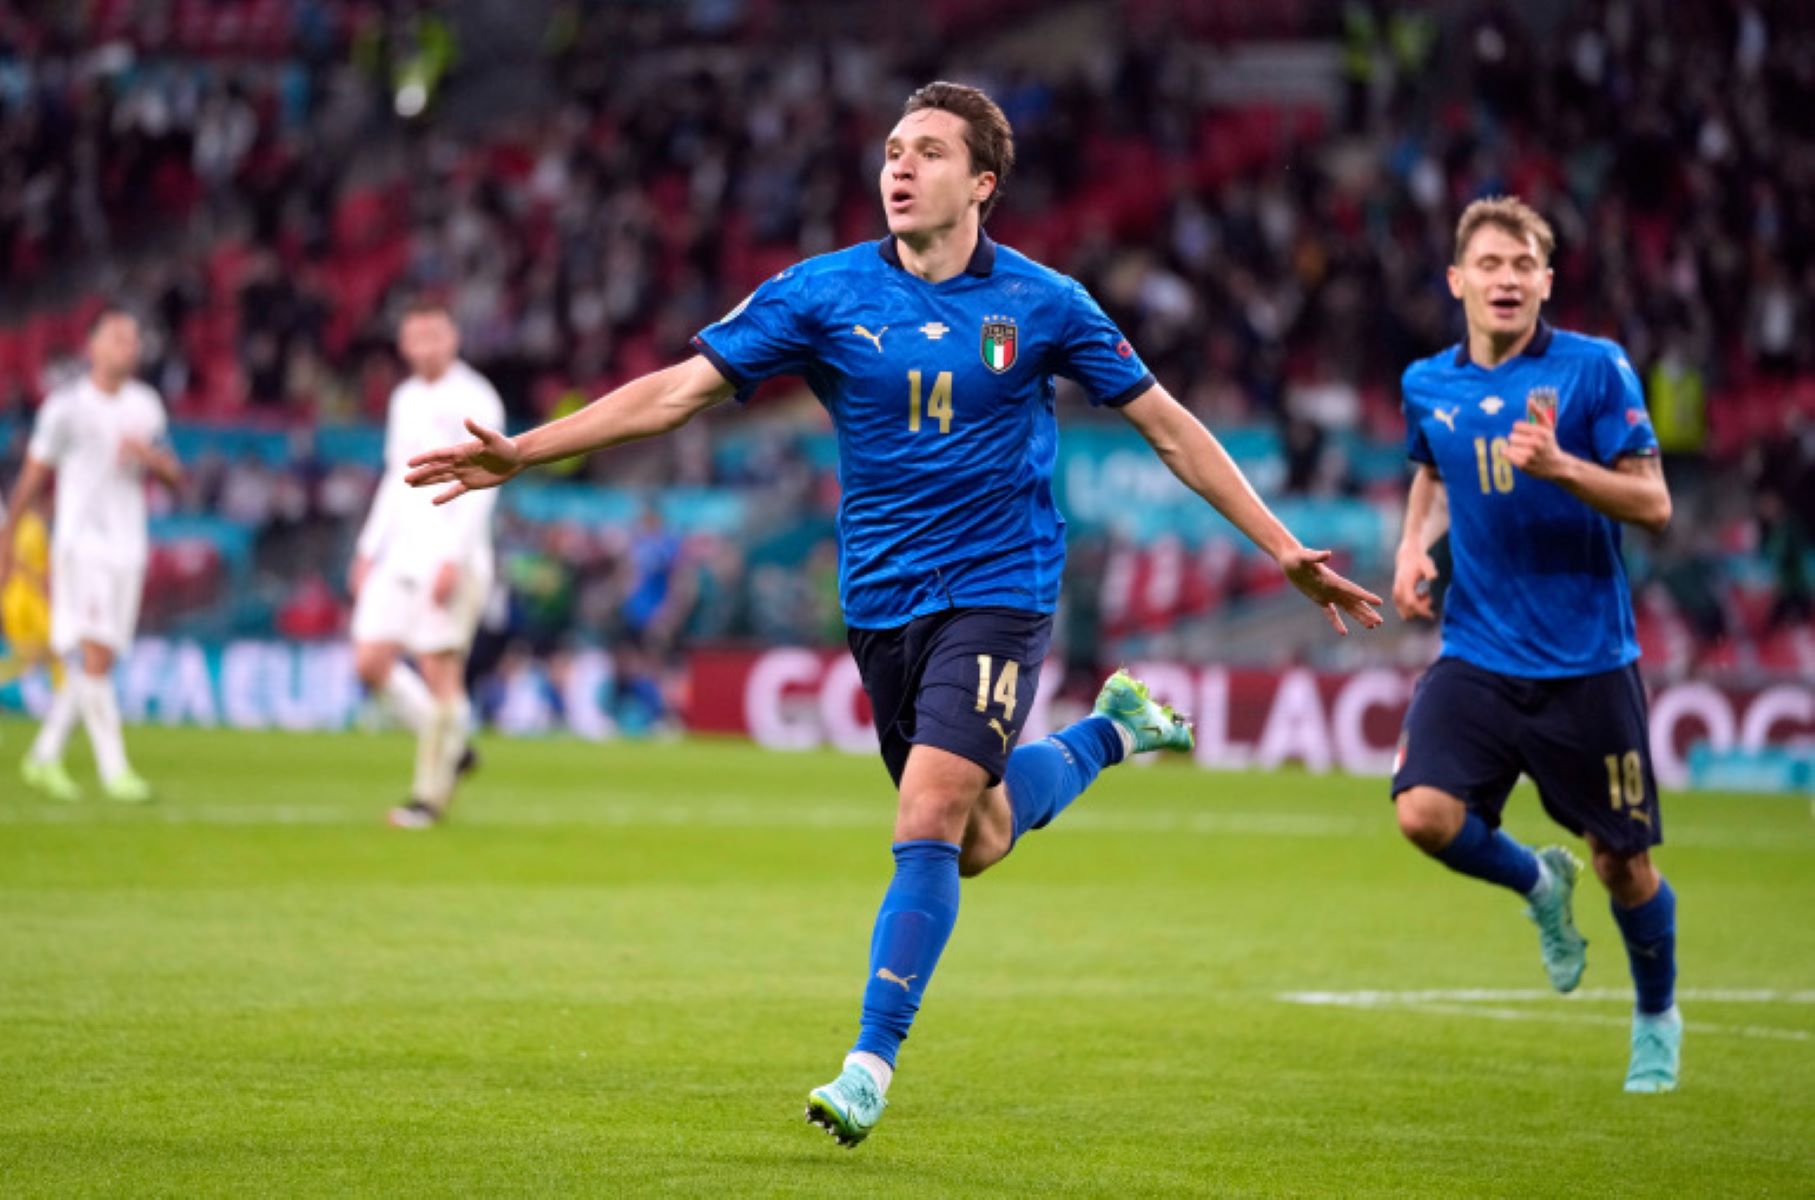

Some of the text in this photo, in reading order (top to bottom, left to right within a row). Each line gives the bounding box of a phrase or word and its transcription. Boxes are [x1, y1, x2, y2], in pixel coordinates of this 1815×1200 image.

[907, 369, 954, 433] 14
[975, 653, 1019, 721] 14
[1605, 750, 1644, 811] 18
